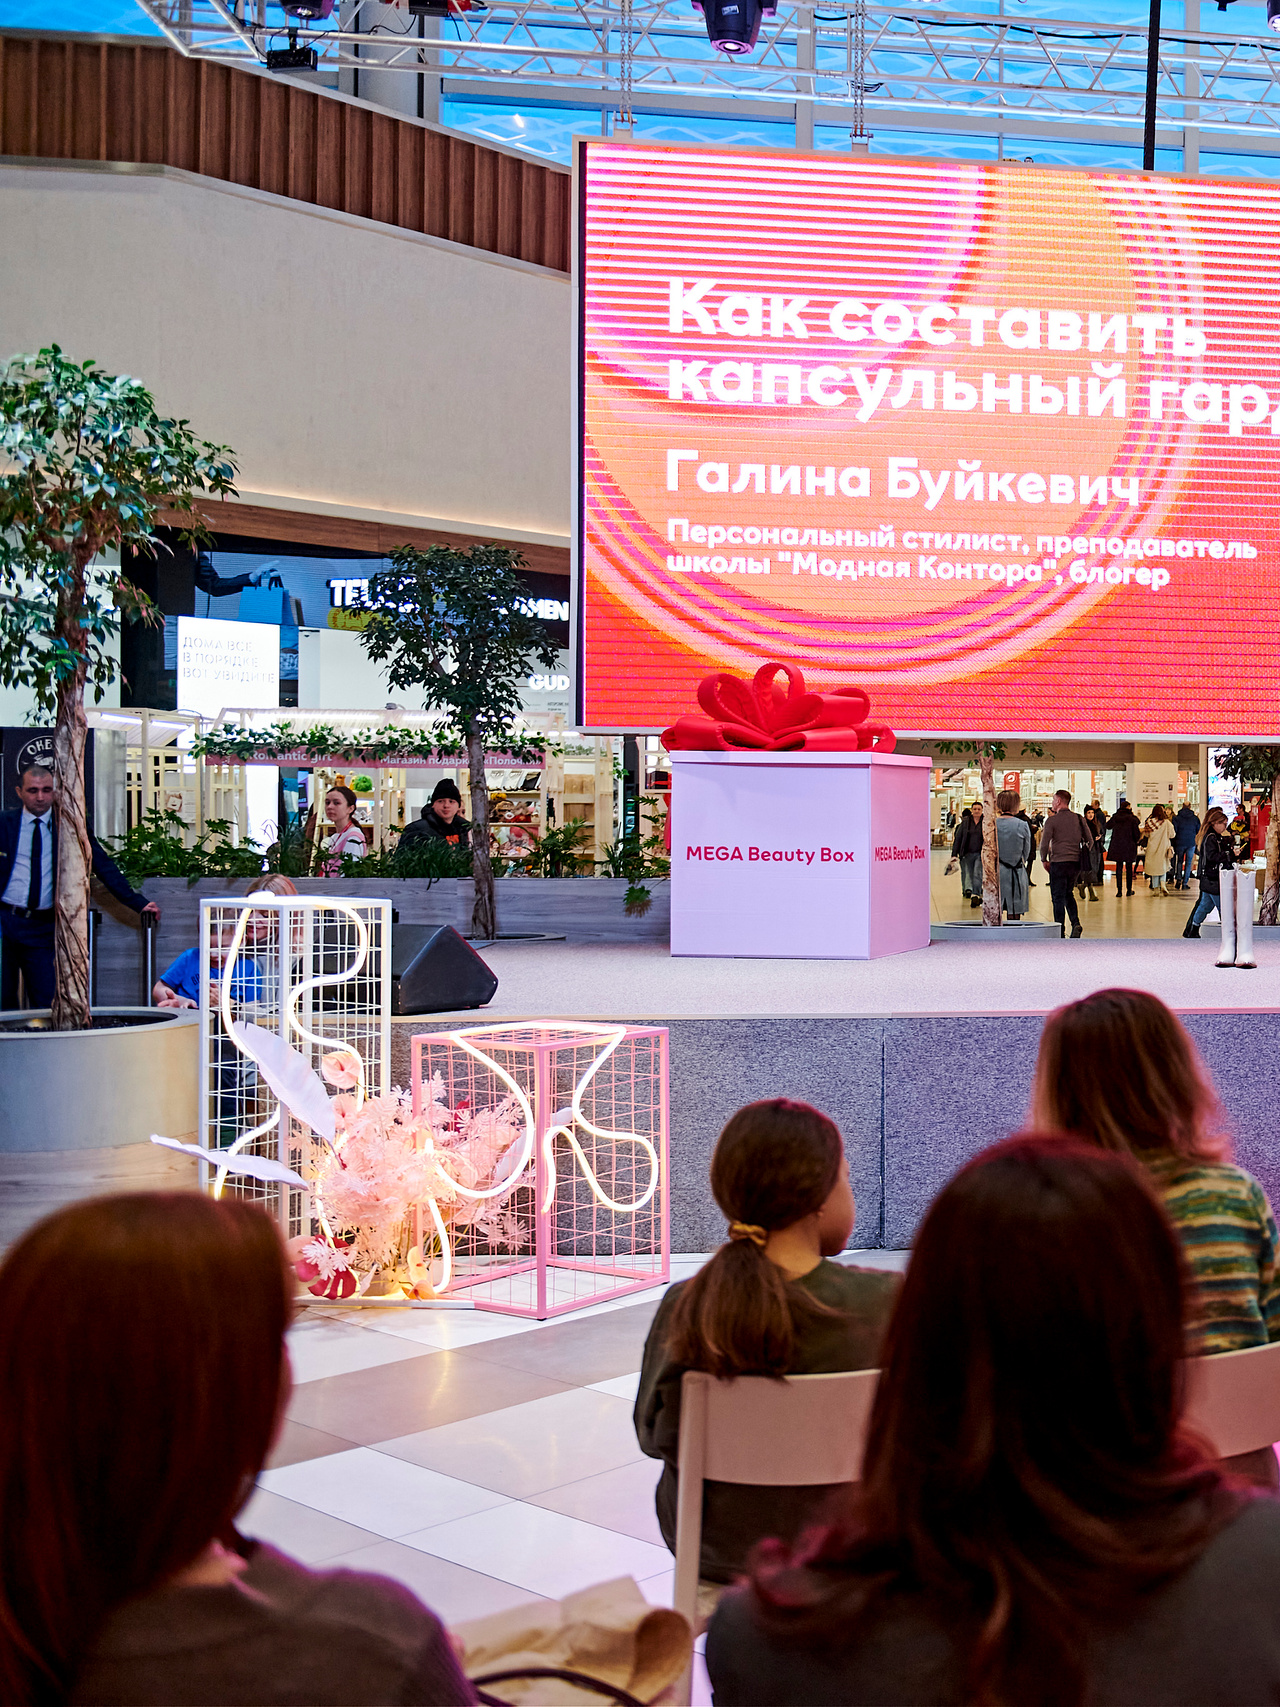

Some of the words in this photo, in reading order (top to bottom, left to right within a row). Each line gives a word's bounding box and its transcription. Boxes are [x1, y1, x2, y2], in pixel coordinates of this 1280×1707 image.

[668, 277, 810, 339] Как
[829, 298, 1207, 357] составить
[668, 359, 1126, 424] капсульный
[667, 449, 871, 497] Галина
[888, 457, 1139, 511] Буйкевич
[667, 518, 895, 548] Персональный
[902, 530, 1030, 555] стилист,
[1036, 535, 1258, 560] преподаватель
[666, 555, 771, 575] школы
[778, 551, 911, 581] "Модная
[918, 555, 1063, 586] Контора",
[1069, 559, 1171, 591] блогер
[183, 636, 222, 650] ДОМА
[227, 640, 252, 652] ВСЕ
[183, 652, 191, 662] В
[195, 653, 259, 667] ПОРЯДКЕ
[214, 671, 275, 683] УВИДИТЕ
[250, 751, 308, 761] Roantic
[381, 756, 426, 765] Магазин
[430, 757, 471, 767] подарк
[686, 846, 744, 861] MEGA
[748, 846, 816, 866] Beauty
[820, 847, 855, 863] Box
[874, 847, 892, 862] MEGA
[892, 847, 914, 863] Beauty
[914, 845, 926, 860] Box
